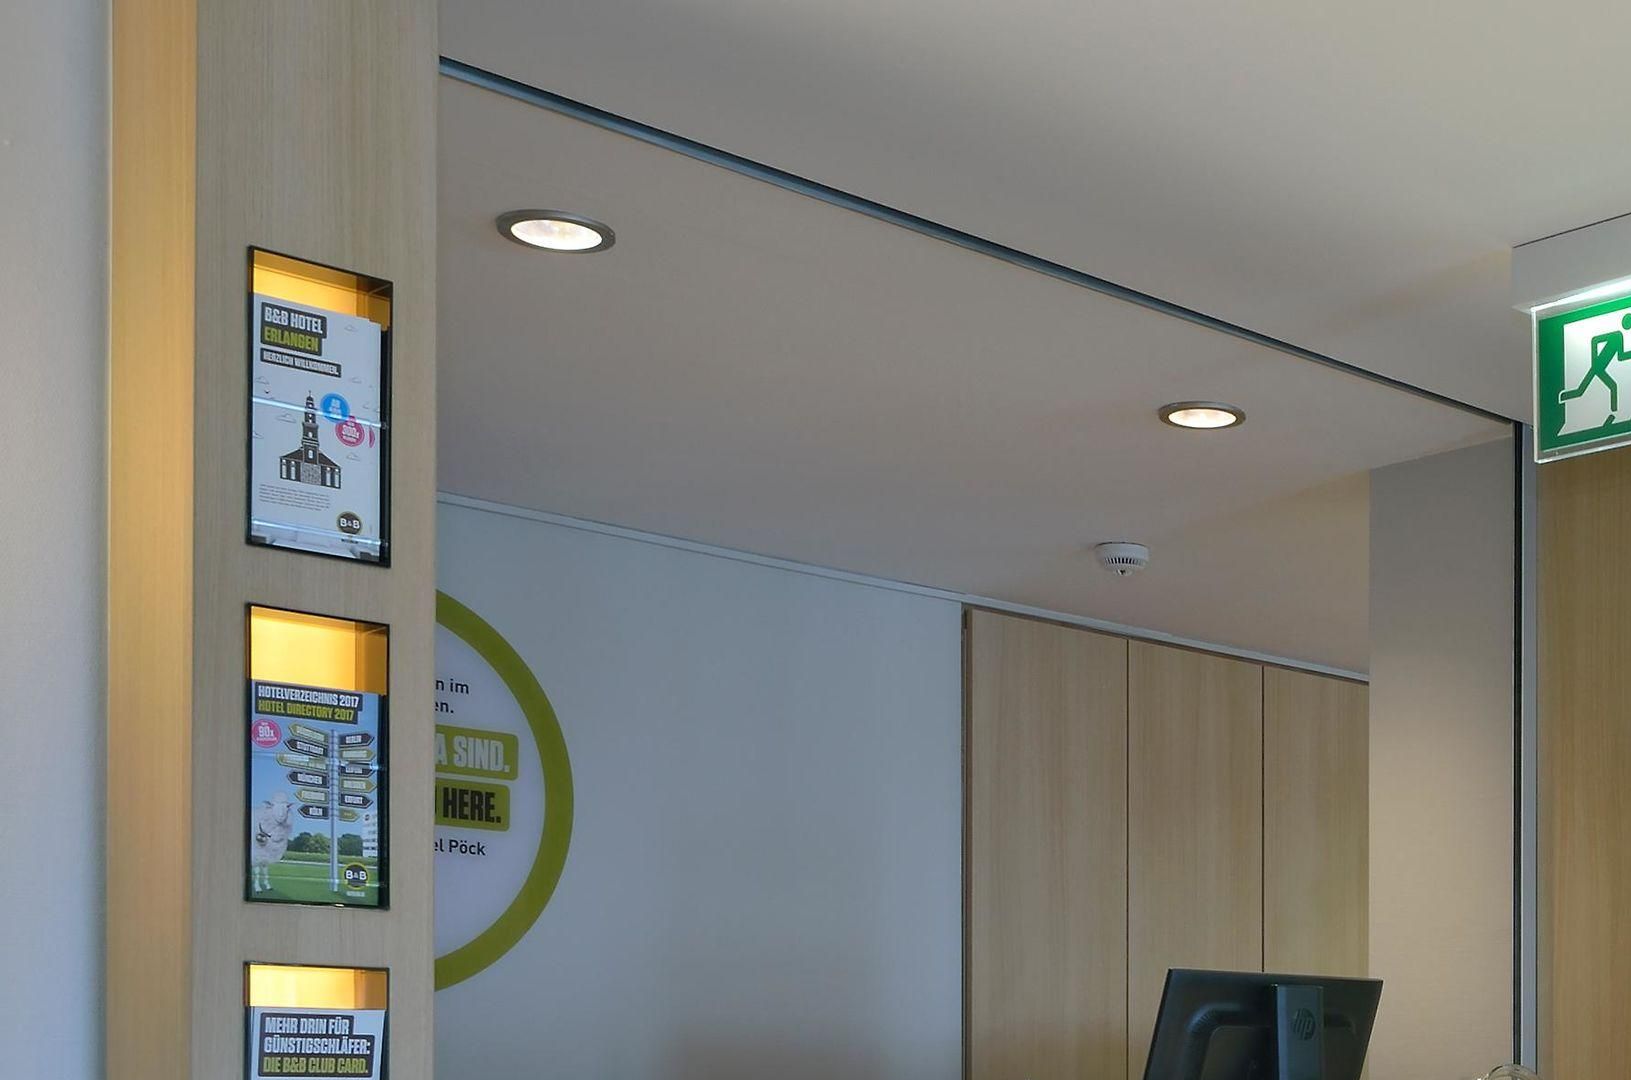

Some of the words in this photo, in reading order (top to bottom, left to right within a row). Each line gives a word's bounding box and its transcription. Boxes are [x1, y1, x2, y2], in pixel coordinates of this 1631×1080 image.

[265, 306, 288, 326] B&B
[290, 311, 323, 334] HOTEL
[258, 685, 338, 706] HOTELVERZEICHNIS
[339, 695, 359, 708] 2017
[450, 678, 469, 694] im
[258, 700, 284, 713] HOTEL
[287, 702, 333, 718] DIRECTORY
[334, 708, 354, 721] 2017
[453, 735, 511, 773] SIND.
[443, 786, 502, 823] HERE.
[449, 838, 486, 856] Pöck
[265, 1017, 298, 1034] MEHR
[299, 1017, 327, 1034] DRIN
[328, 1016, 350, 1035] FÜR
[263, 1034, 371, 1055] GÜNSTIGSCHLÄFER:
[263, 1056, 281, 1073] DIE
[282, 1056, 307, 1073] B&B
[308, 1057, 336, 1073] CLUB
[337, 1057, 369, 1074] CARD.
